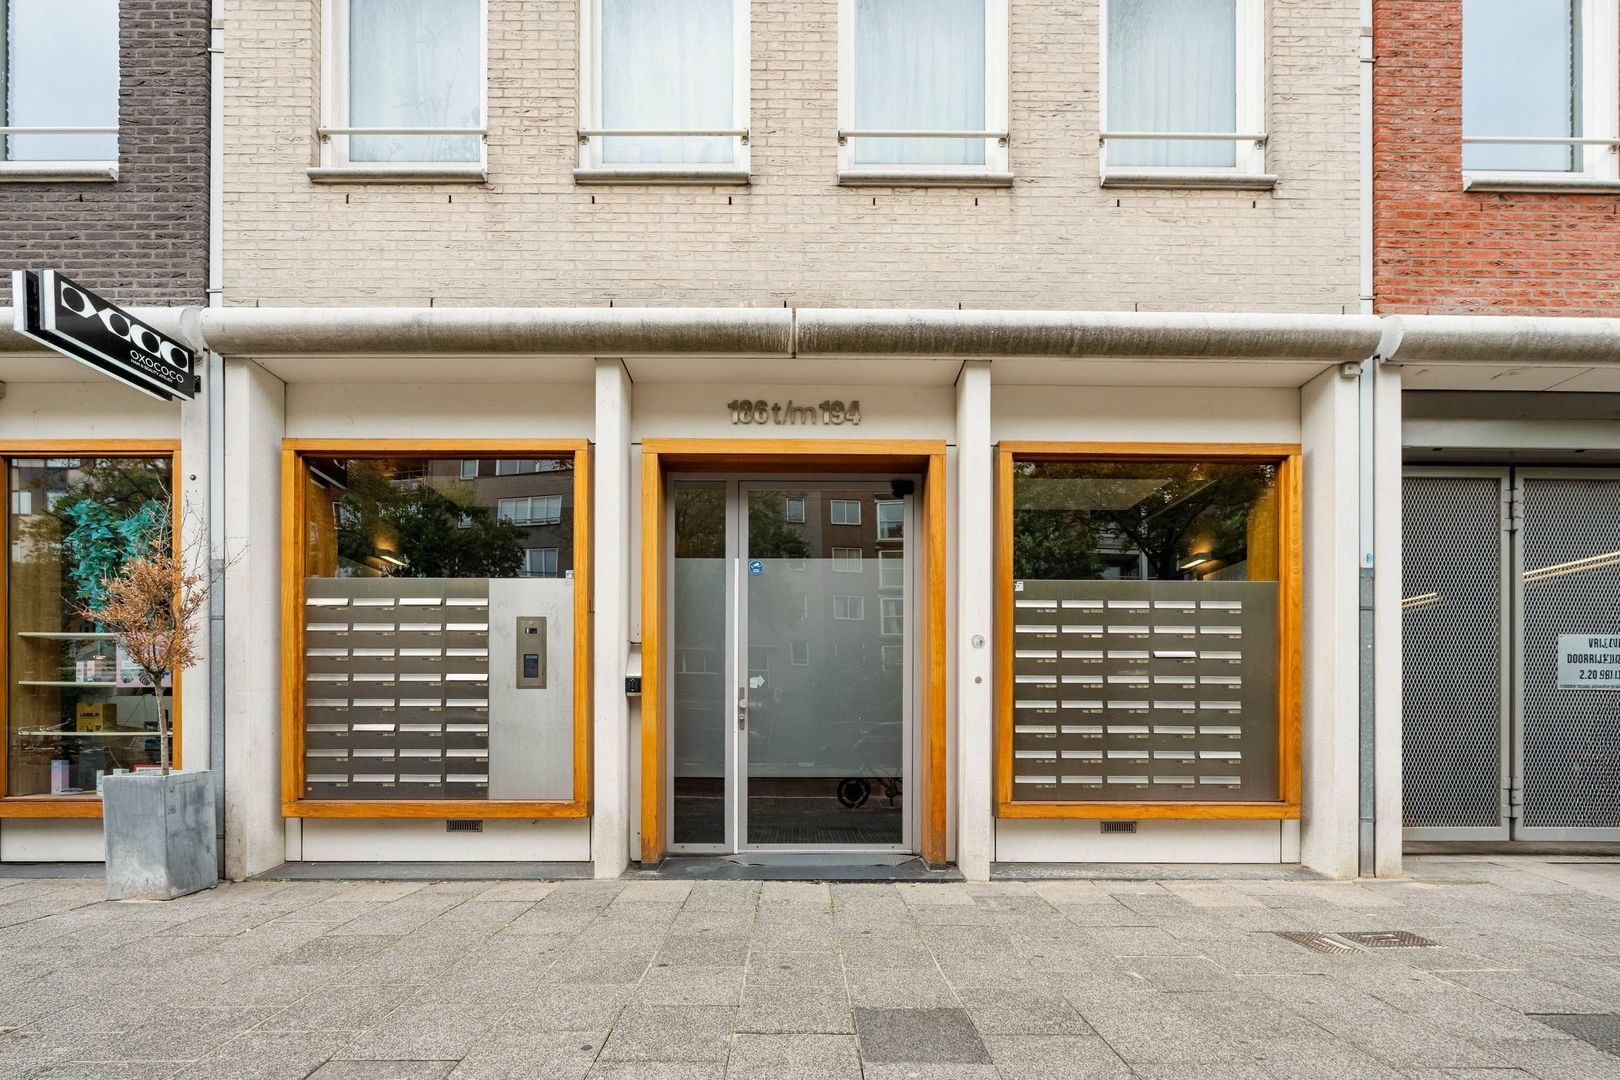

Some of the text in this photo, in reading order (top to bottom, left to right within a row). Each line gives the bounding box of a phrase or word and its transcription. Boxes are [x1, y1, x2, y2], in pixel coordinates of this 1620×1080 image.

[130, 349, 184, 383] OXOCOCO
[771, 399, 817, 425] t/m
[818, 400, 862, 425] 194
